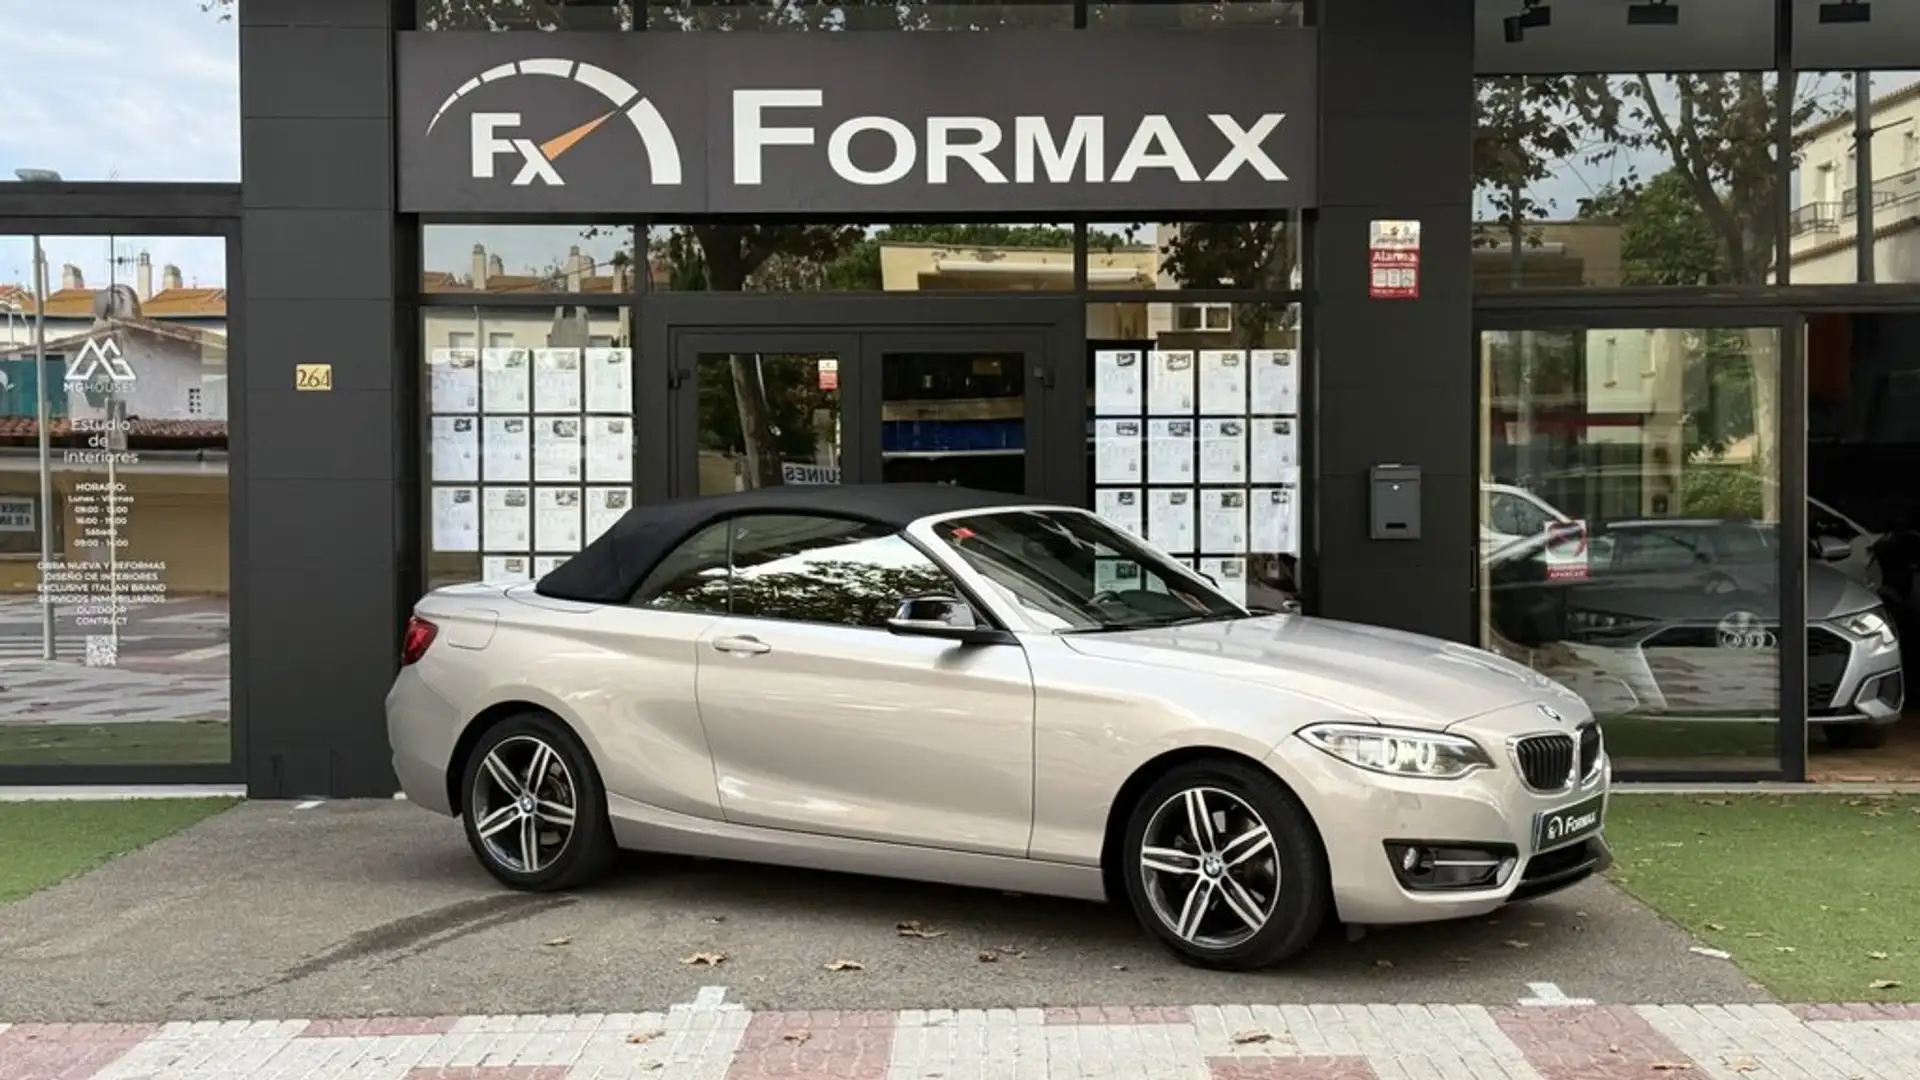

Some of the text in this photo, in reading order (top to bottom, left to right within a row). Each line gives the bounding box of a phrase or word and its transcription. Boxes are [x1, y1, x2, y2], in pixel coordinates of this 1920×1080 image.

[732, 88, 1290, 185] FORMAX
[297, 368, 330, 388] 264
[63, 382, 137, 393] MGHOUSES
[71, 418, 131, 431] Estudio
[88, 435, 109, 447] de
[63, 451, 140, 464] Interiores
[67, 562, 101, 570] NUEVA
[45, 571, 158, 580] DISEÑO DE INTERIORES
[37, 583, 89, 592] EXCLUSIVE
[131, 583, 166, 592] BRAND
[38, 594, 89, 603] SERVICIOS
[76, 605, 126, 614] OUTDOOR
[75, 616, 128, 625] CONTRACT
